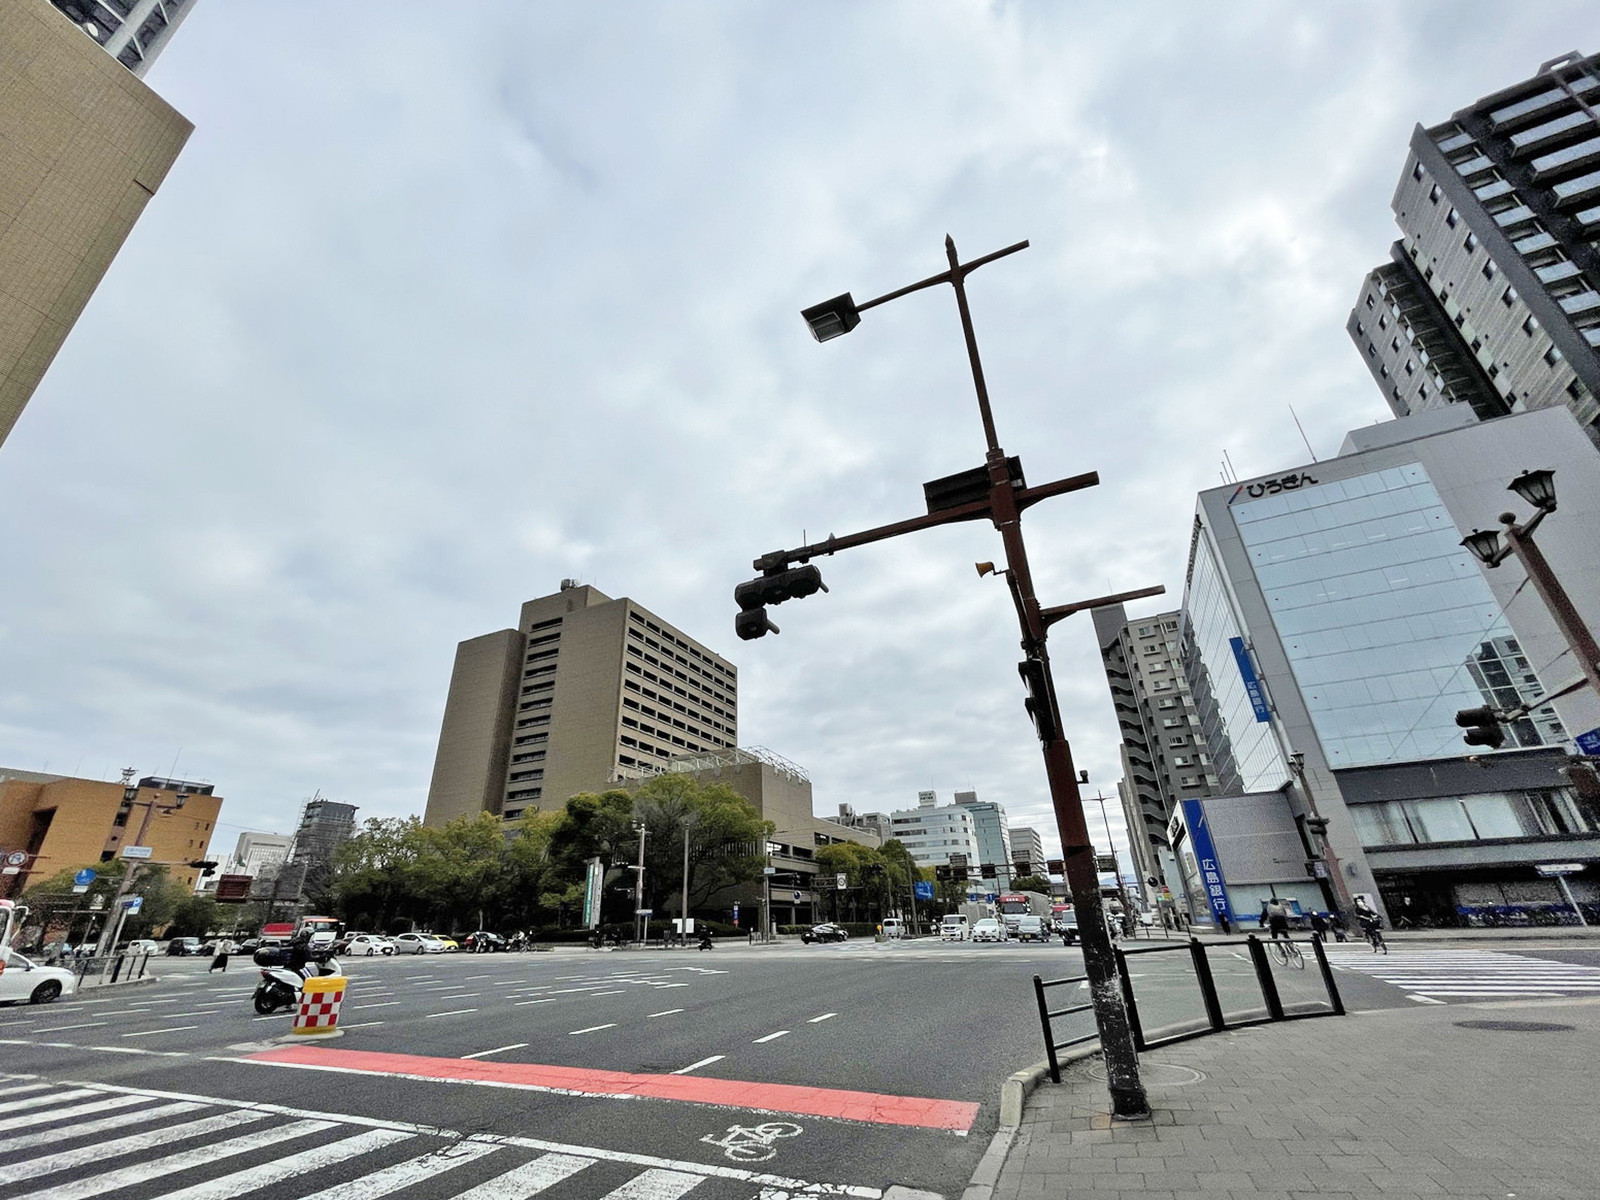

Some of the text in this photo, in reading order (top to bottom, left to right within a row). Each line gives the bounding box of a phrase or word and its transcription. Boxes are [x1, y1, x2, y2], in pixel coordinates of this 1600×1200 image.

[1246, 471, 1319, 498] ひろぎん
[1202, 858, 1226, 910] 広島銀行
